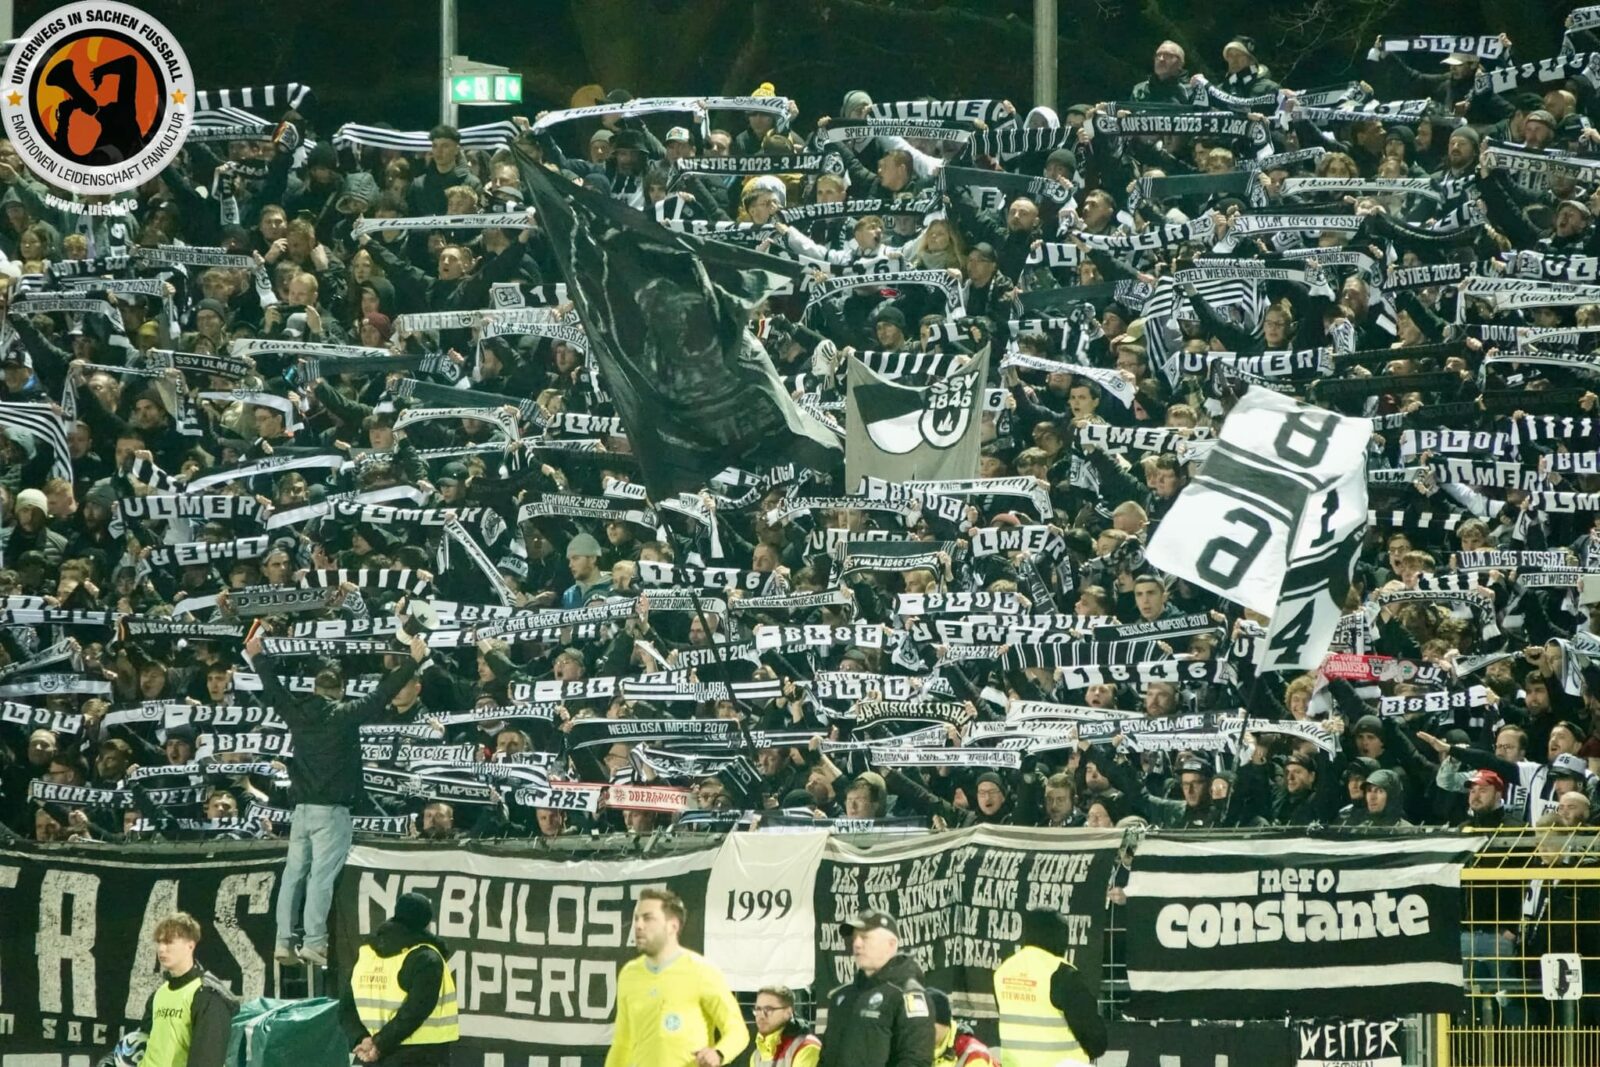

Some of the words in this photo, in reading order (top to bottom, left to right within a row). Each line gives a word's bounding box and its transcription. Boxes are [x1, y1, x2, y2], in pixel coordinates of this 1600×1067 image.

[873, 101, 986, 121] ULME
[844, 128, 871, 142] SPIELT
[873, 128, 904, 142] WIEDER
[907, 128, 960, 143] BUNDESWEIT
[1121, 117, 1172, 132] AUFSTIEG
[1174, 117, 1202, 132] 2023
[677, 157, 737, 172] AUFSTIEG
[740, 157, 770, 171] 2023
[784, 202, 843, 222] AUFSTIEG
[845, 199, 881, 215] 2023
[165, 252, 194, 263] WIEDER
[196, 254, 249, 266] BUNDESWEIT
[1174, 268, 1203, 283] SPIELT
[1206, 266, 1236, 281] WIEDER
[175, 355, 200, 369] SSV
[202, 357, 227, 371] ULM
[929, 372, 979, 395] SSV
[928, 389, 972, 409] 1846
[1373, 475, 1406, 487] ULM
[123, 495, 257, 519] ULMER
[541, 493, 610, 509] SCHWARZ-WEISS
[1461, 551, 1488, 567] ULM
[1489, 551, 1518, 567] 1846
[238, 589, 326, 613] D-BLOCK
[1118, 622, 1155, 638] NEBULOSA
[1157, 619, 1187, 634] IMPERO
[1188, 614, 1209, 630] 2010
[1267, 598, 1316, 665] 4
[1065, 662, 1208, 689] 1846
[607, 721, 662, 735] NEBULOSA
[664, 722, 702, 735] IMPERO
[628, 790, 688, 805] OBERHAUSEN
[830, 865, 860, 893] DAS
[864, 863, 901, 893] ZIEL
[977, 849, 1026, 881] EINE
[1026, 852, 1095, 884] KURVE
[1261, 867, 1337, 894] nero
[724, 888, 792, 922] 1999
[835, 894, 860, 922] DIE
[972, 877, 1019, 911] LANG
[1026, 882, 1073, 914] BEBT
[987, 911, 1023, 942] RAD
[1155, 891, 1431, 950] constante
[1299, 1020, 1399, 1060] WEITER
